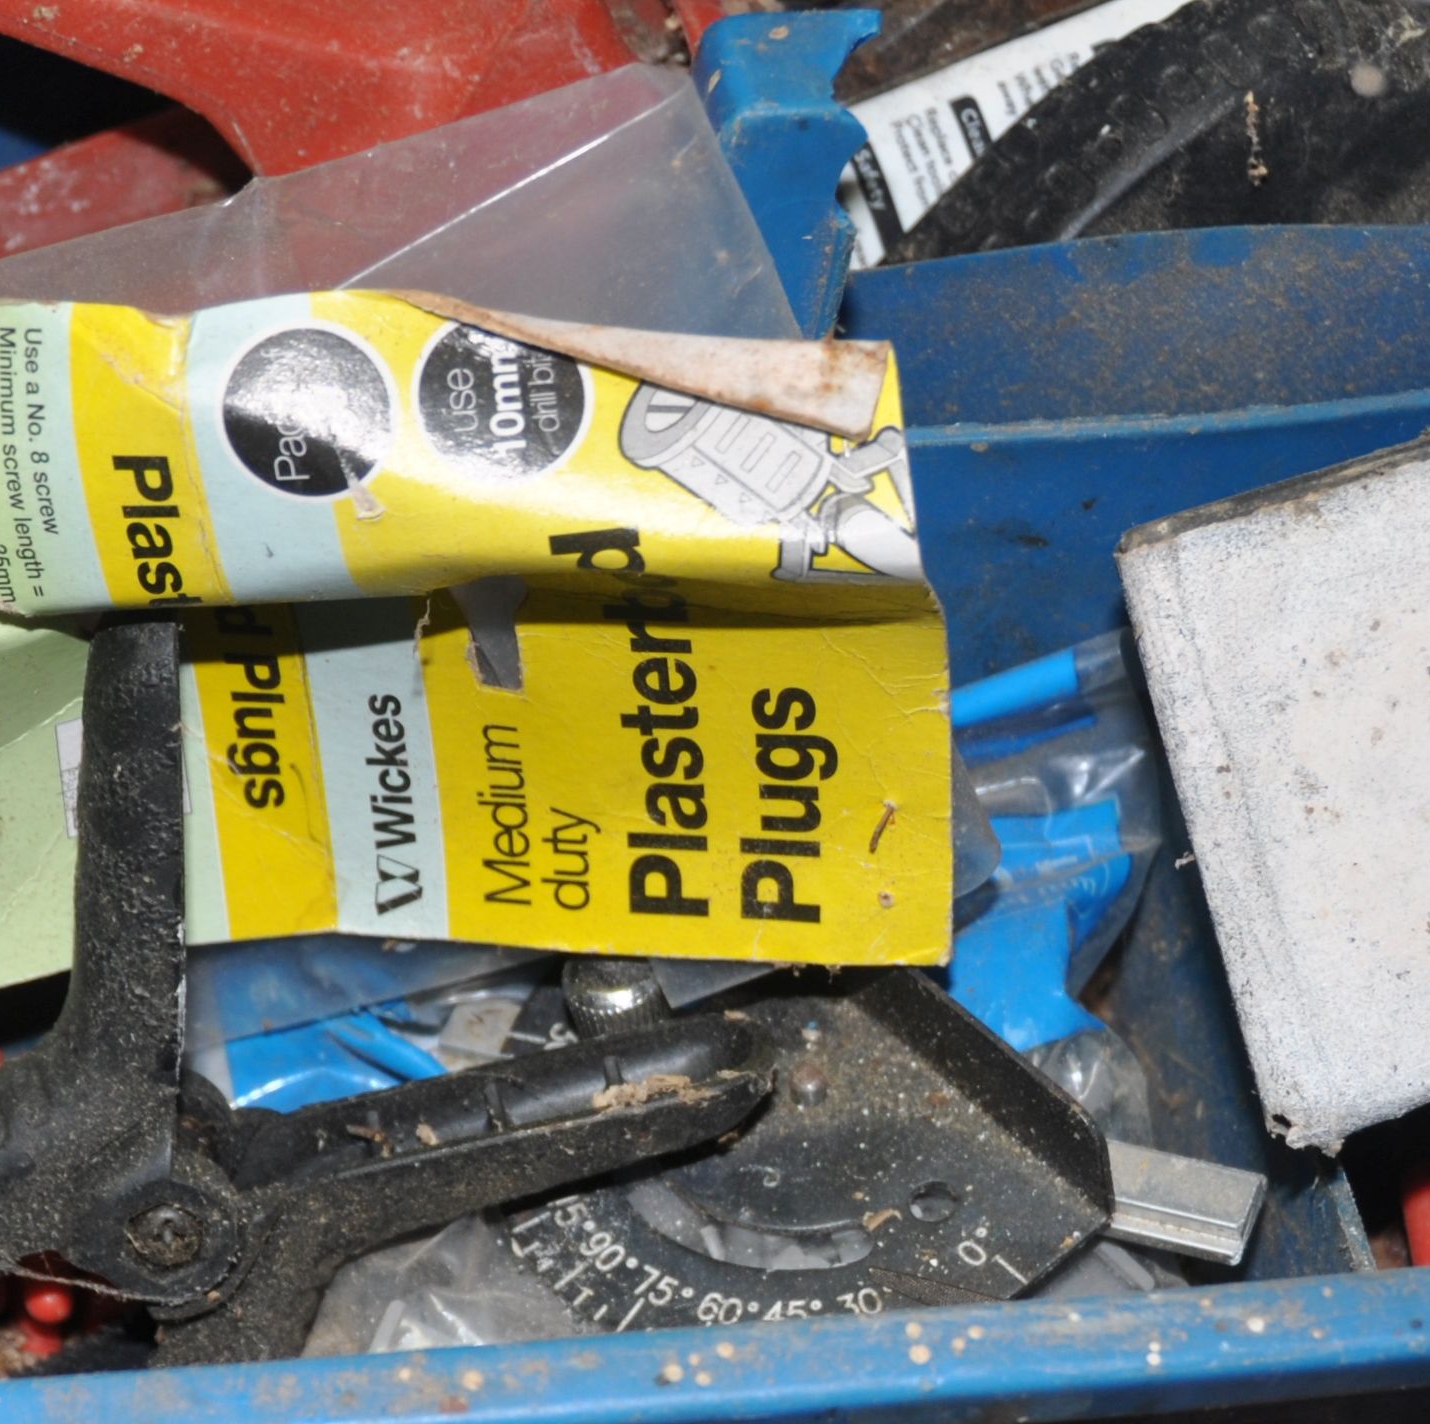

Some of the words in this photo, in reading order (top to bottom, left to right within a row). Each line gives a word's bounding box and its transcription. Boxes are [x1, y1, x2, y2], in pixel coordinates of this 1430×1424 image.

[23, 327, 45, 375] Use
[27, 380, 41, 395] a
[446, 368, 479, 432] use
[529, 392, 561, 433] drill
[27, 403, 47, 443] No.
[273, 424, 311, 481] Pac
[30, 450, 52, 465] 8
[2, 443, 26, 511] screw
[14, 508, 44, 589] length
[31, 470, 60, 537] screw
[223, 653, 287, 809] Plugs
[367, 692, 416, 847] Wickes
[484, 723, 532, 907] Medium
[739, 686, 839, 924] Plugs
[552, 806, 600, 910] duty
